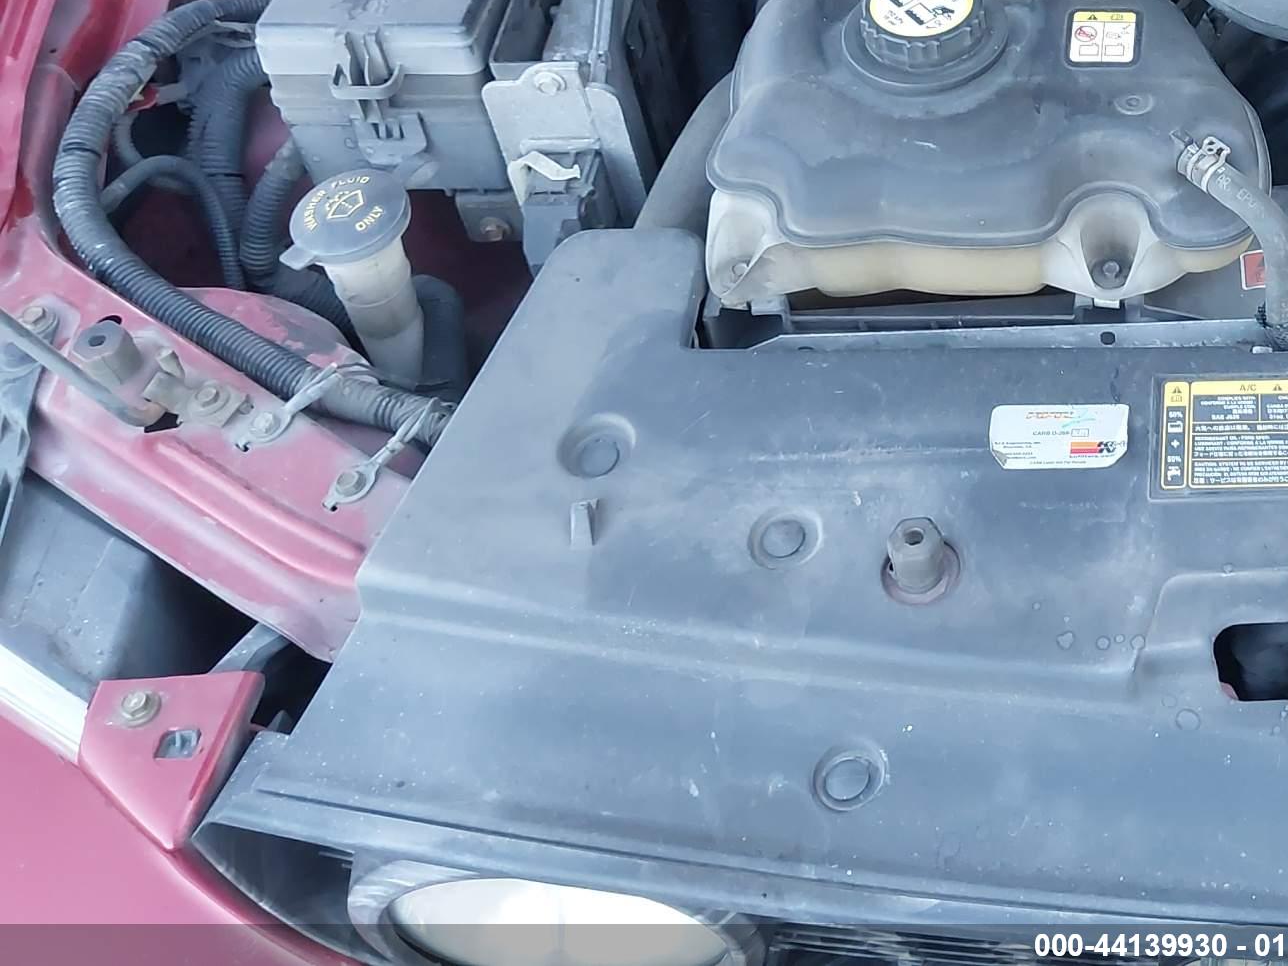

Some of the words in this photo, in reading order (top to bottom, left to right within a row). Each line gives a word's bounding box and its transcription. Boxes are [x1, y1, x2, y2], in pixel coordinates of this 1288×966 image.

[331, 176, 370, 188] FLUID
[355, 205, 384, 231] ONLY
[1240, 384, 1257, 392] A/C
